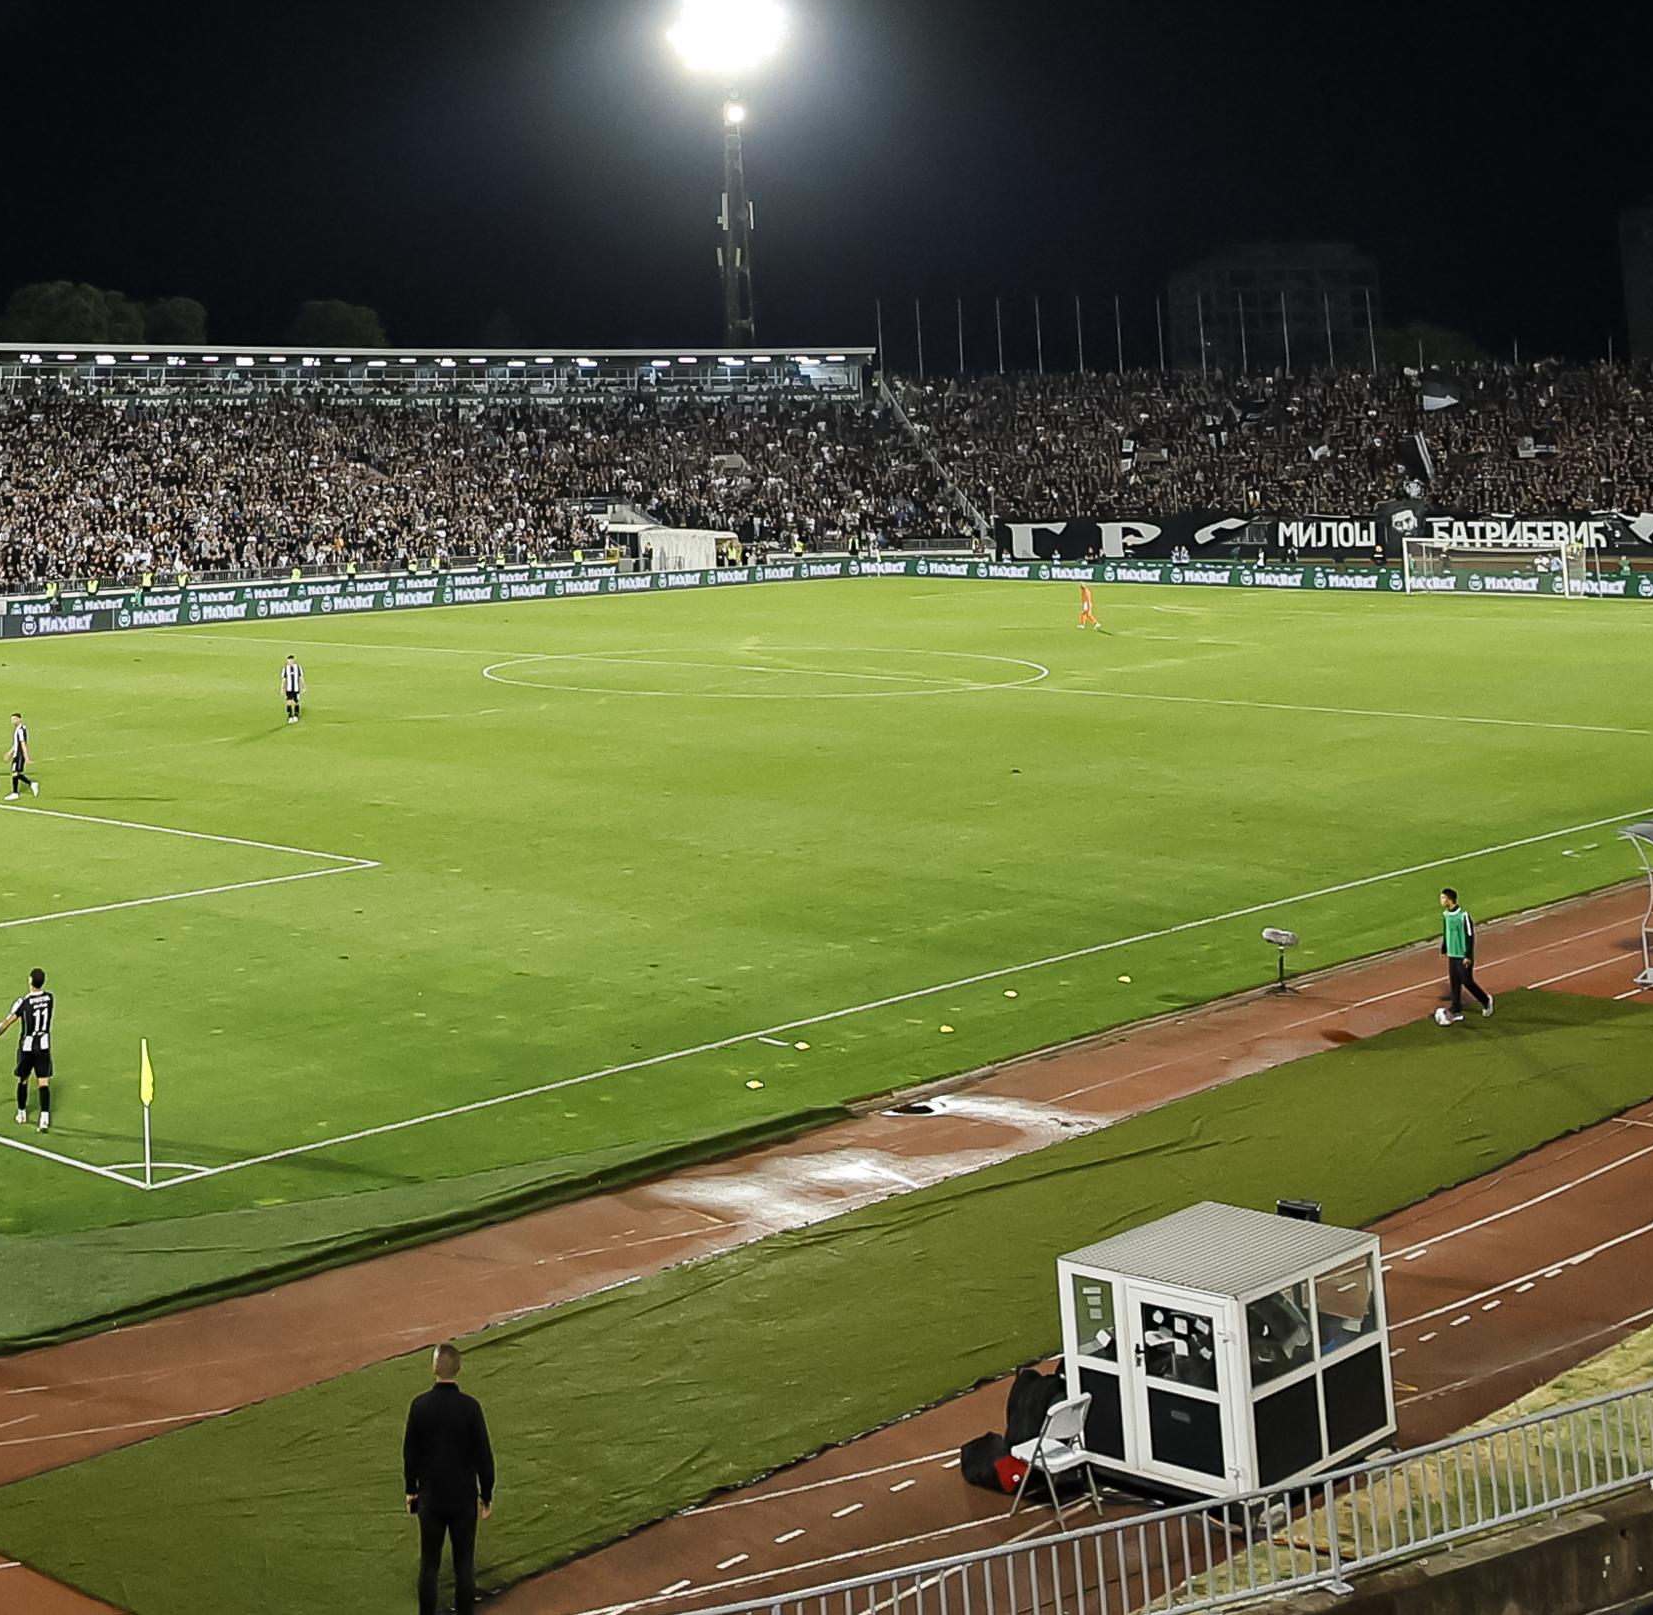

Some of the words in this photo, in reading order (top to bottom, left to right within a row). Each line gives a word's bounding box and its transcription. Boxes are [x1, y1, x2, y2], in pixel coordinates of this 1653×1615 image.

[1278, 521, 1375, 547] МИЛОШ
[861, 561, 907, 574] MAXBET
[989, 565, 1030, 578] MAXBET
[1051, 566, 1094, 580] MAXBET
[1116, 568, 1161, 582] MAXBET
[1184, 570, 1230, 584] MAXBET
[1255, 572, 1303, 586] MAXBET
[1328, 574, 1377, 589] MAXBET
[1485, 576, 1539, 592] MAXBET
[1570, 579, 1626, 594] MAXBET
[269, 599, 313, 615] MAXBET
[333, 595, 375, 610] MAXBET
[133, 608, 179, 625] MAXBET
[203, 603, 247, 620] MAXBET
[39, 614, 93, 633] MAXBET
[33, 1009, 49, 1032] 11
